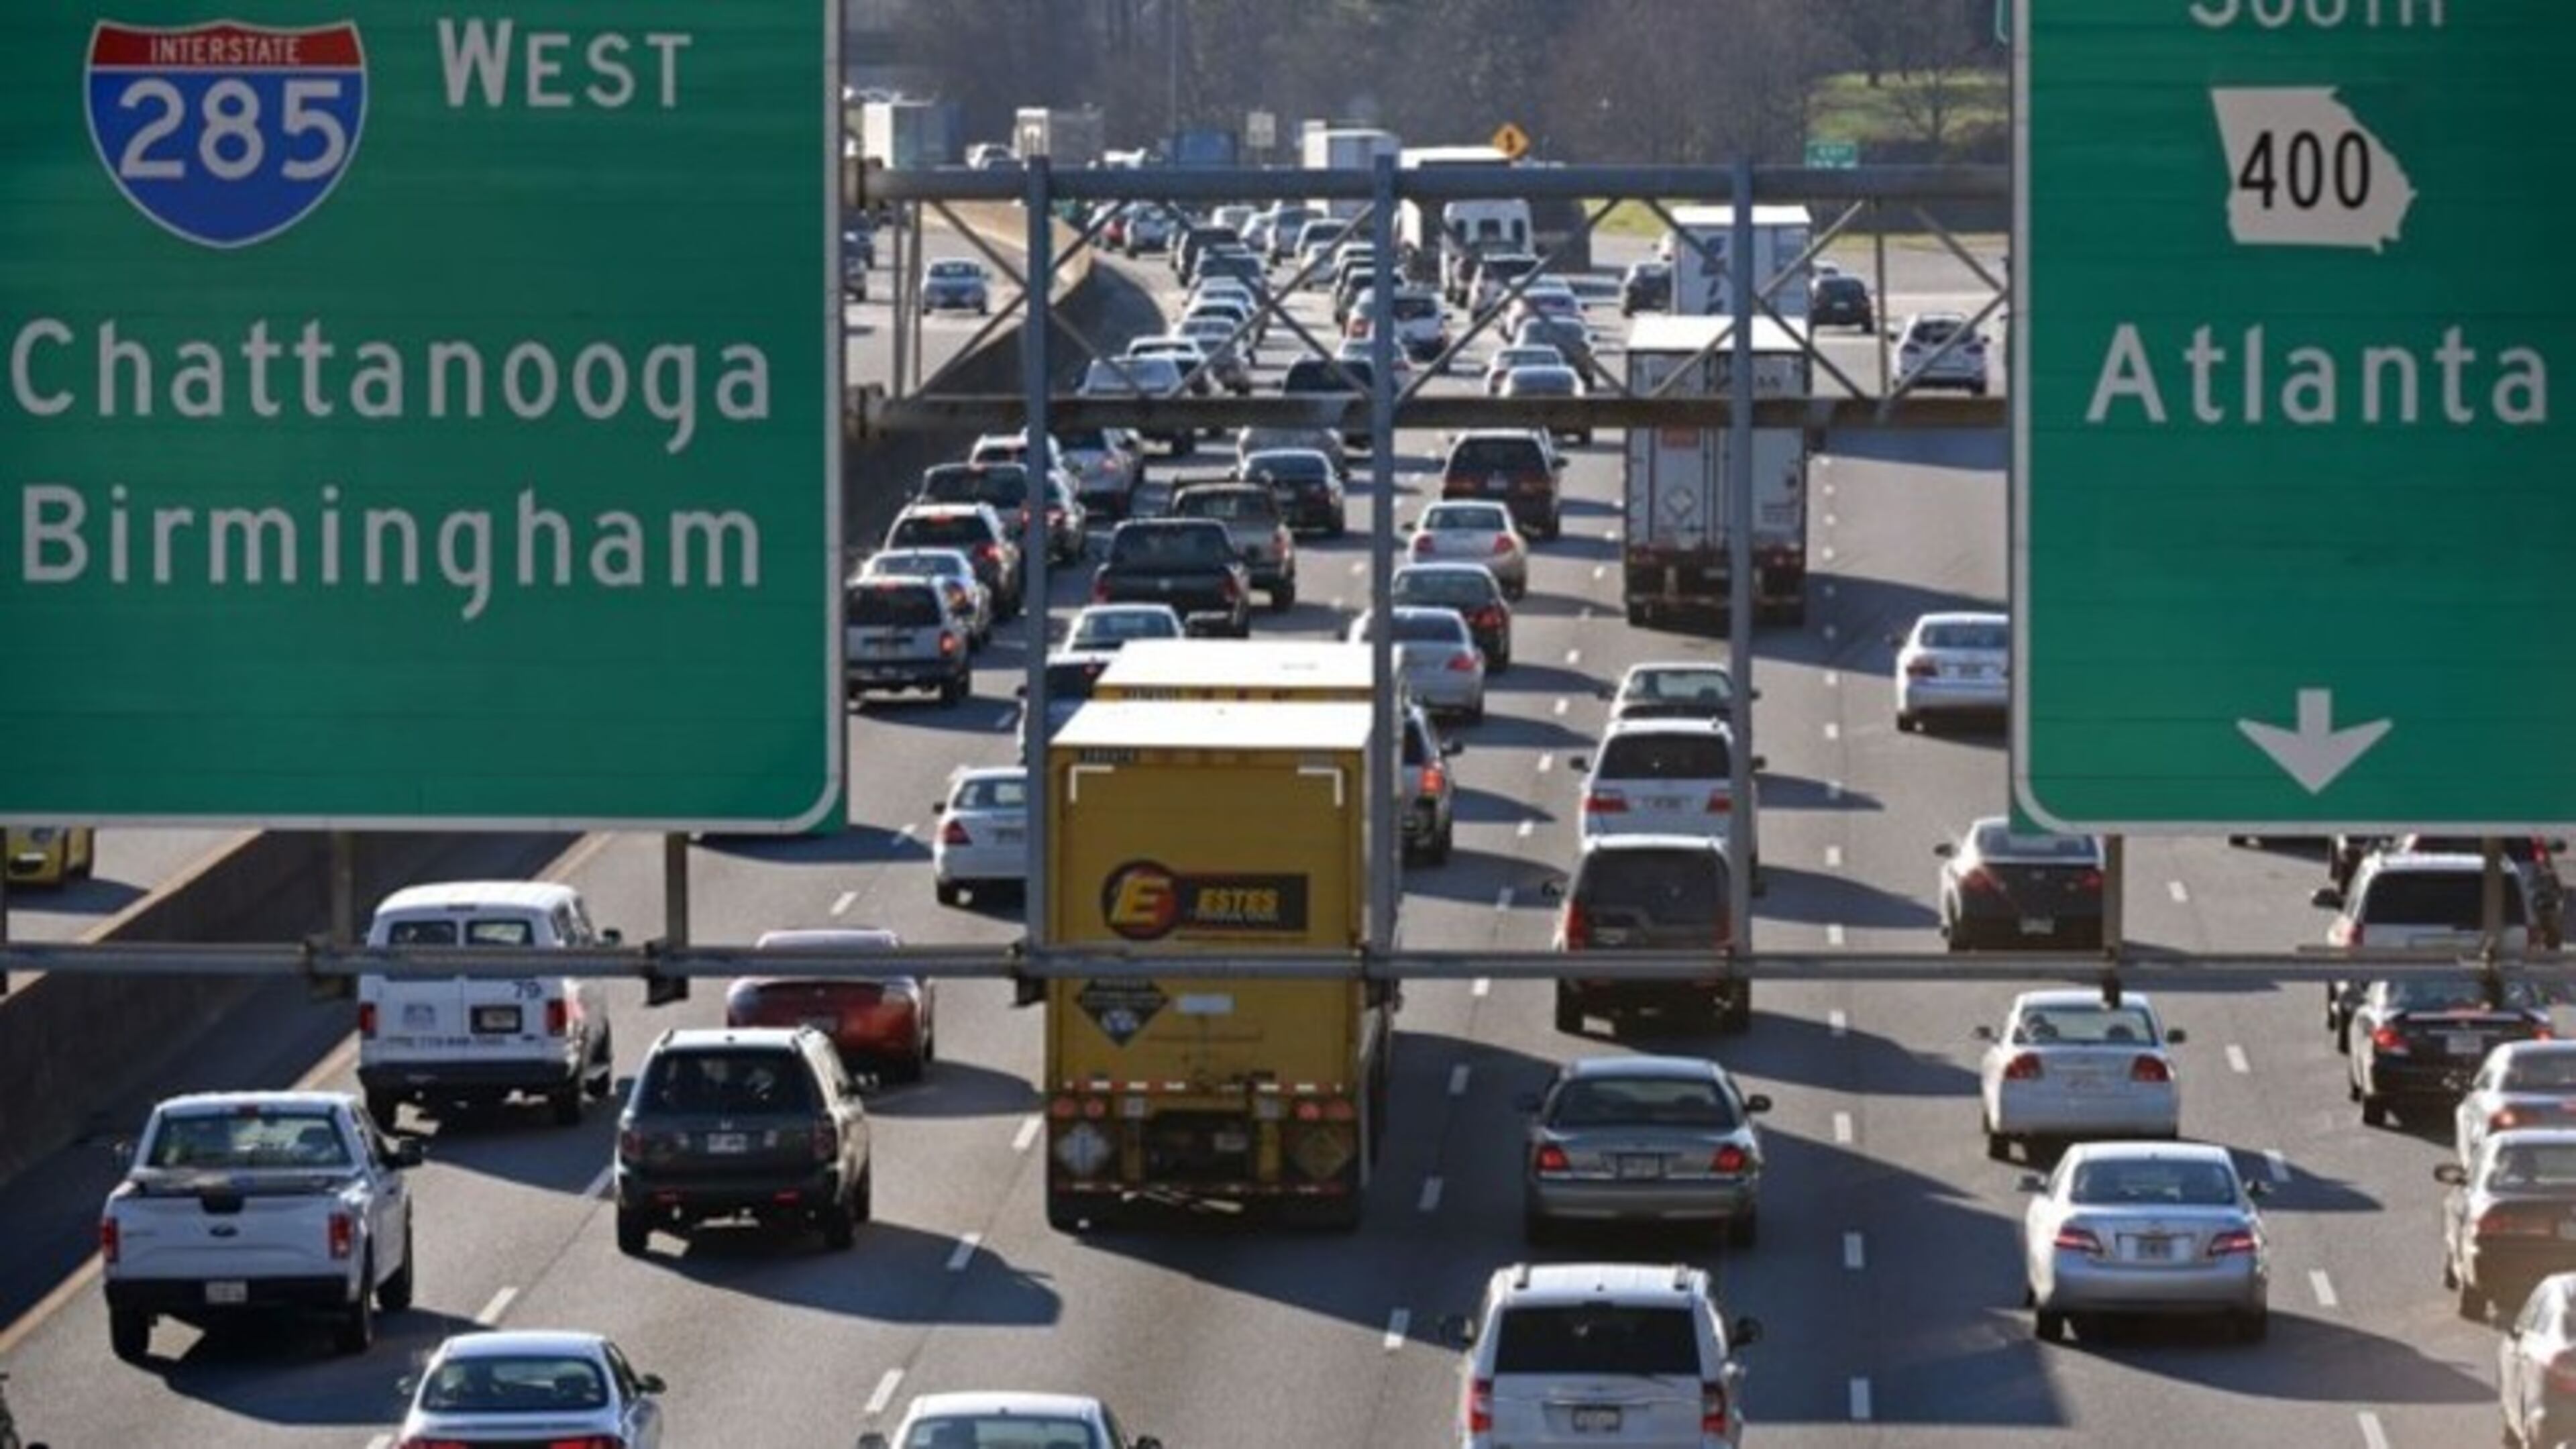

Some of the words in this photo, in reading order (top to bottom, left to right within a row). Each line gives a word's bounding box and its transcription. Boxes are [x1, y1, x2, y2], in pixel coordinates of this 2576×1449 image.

[150, 36, 301, 65] INTERSTATE
[437, 18, 692, 107] WEST
[119, 78, 346, 180] 285
[2238, 130, 2371, 210] 400
[11, 318, 769, 453] Chattanooga
[2086, 323, 2546, 424] Atlanta
[23, 484, 759, 621] Birmingham
[1110, 875, 1170, 925] E
[1197, 886, 1280, 914] ESTES
